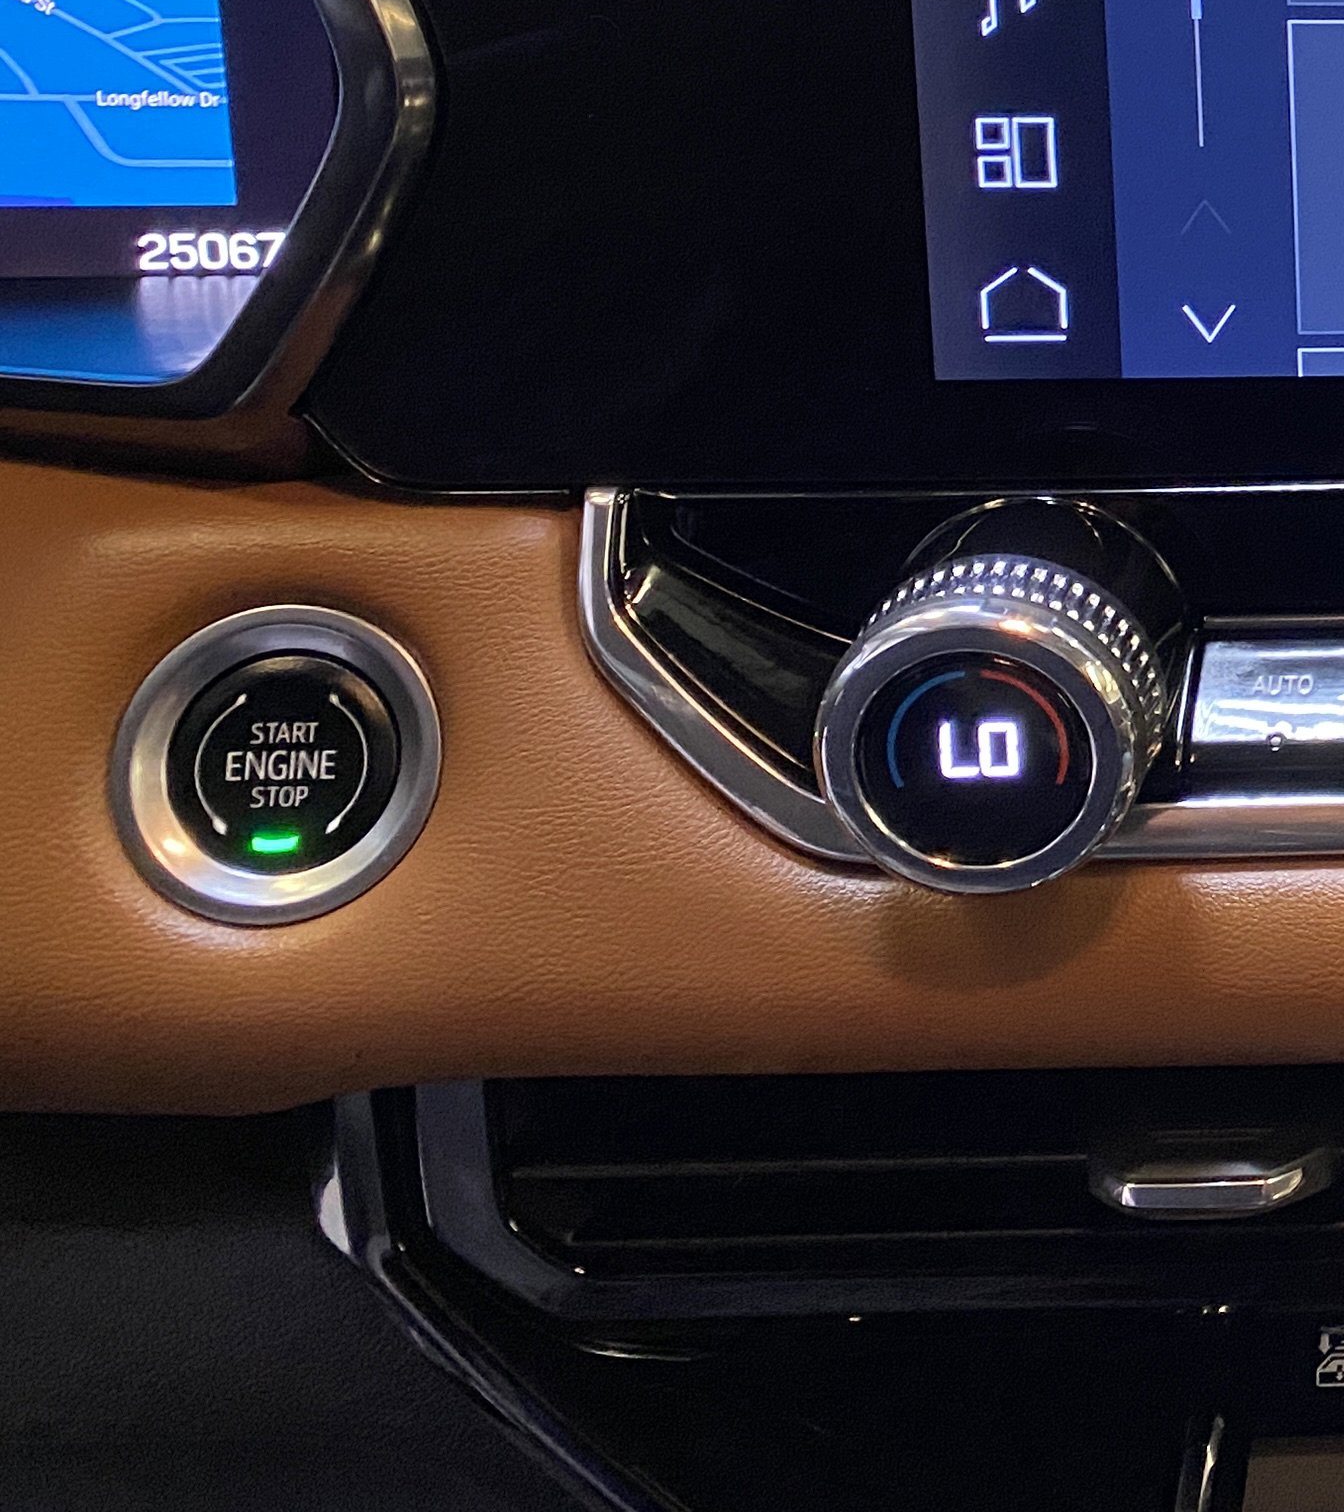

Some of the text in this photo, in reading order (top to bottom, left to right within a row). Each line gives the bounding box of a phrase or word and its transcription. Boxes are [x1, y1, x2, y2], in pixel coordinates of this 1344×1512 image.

[95, 89, 222, 111] Longfellow Dr
[136, 231, 288, 271] 25067
[1251, 672, 1316, 696] AUTO
[249, 721, 320, 746] START
[937, 719, 1021, 780] LO
[224, 748, 339, 782] ENGINE
[249, 786, 310, 810] STOP
